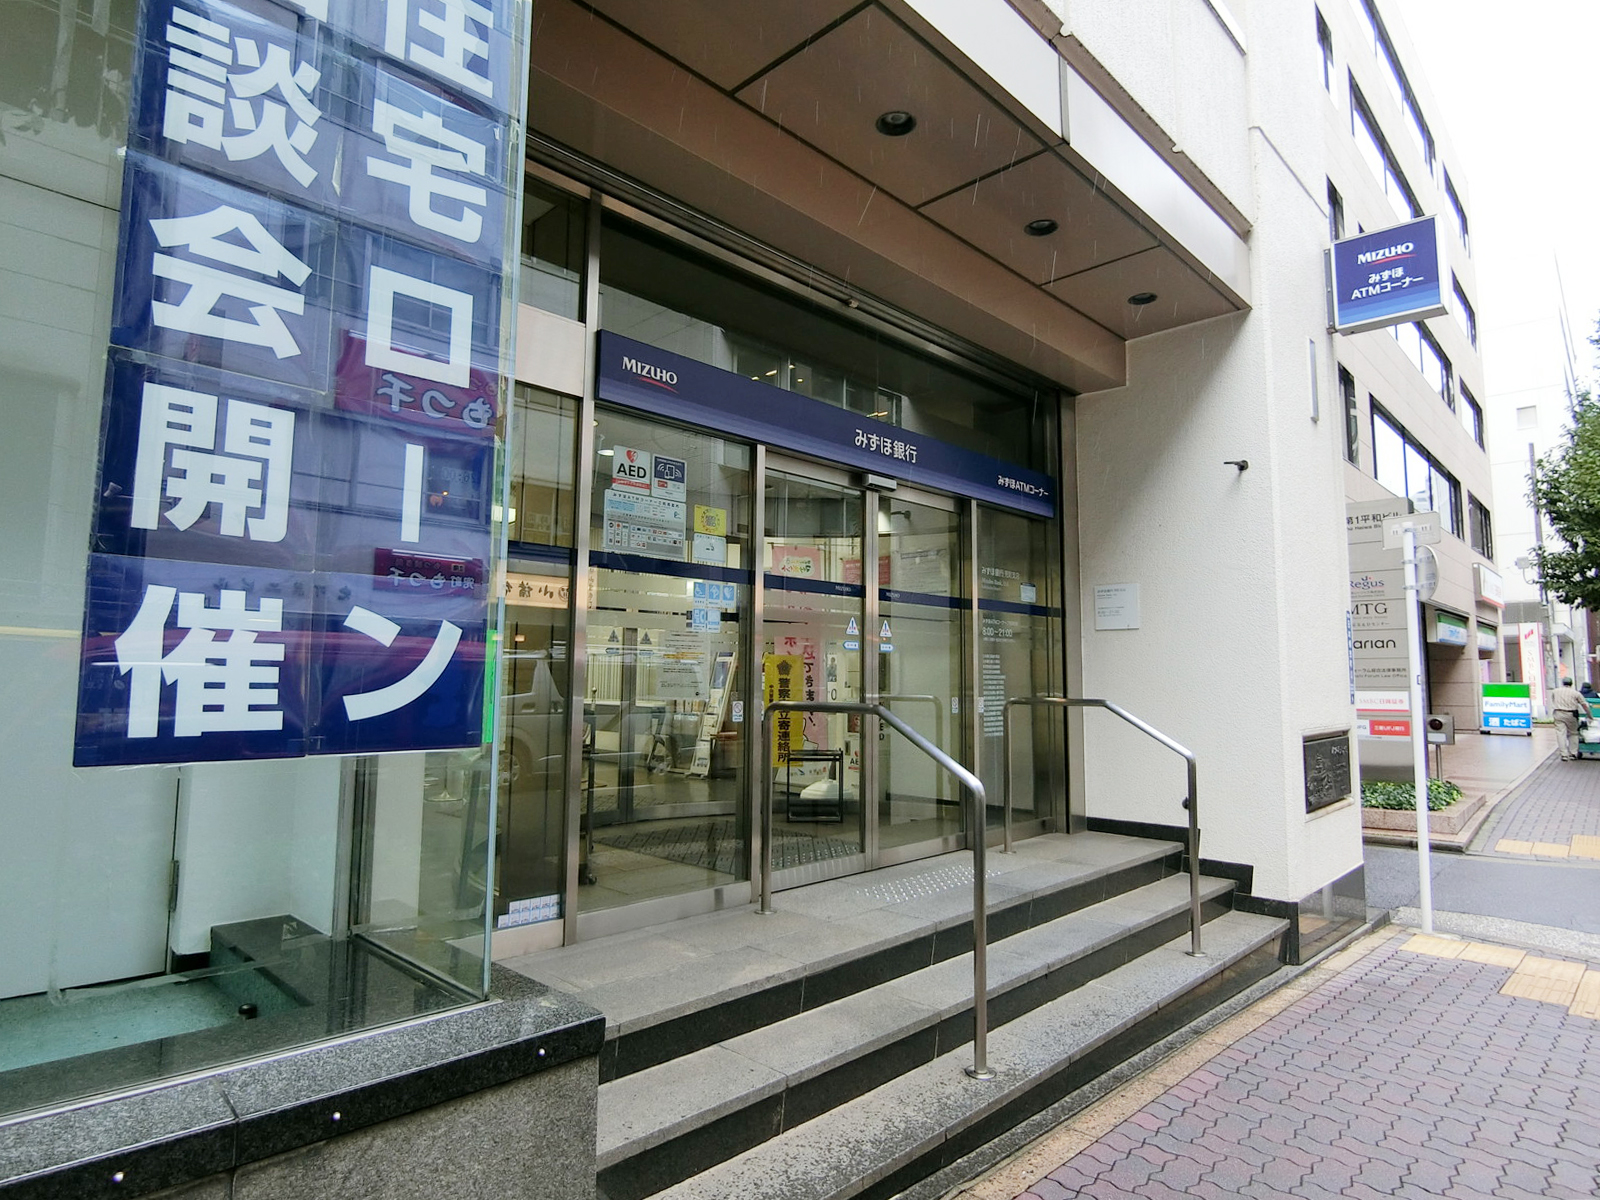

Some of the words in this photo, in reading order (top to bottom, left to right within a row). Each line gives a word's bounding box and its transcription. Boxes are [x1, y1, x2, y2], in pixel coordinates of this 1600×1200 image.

[1357, 242, 1414, 265] MIZUHO
[1368, 266, 1405, 284] みずほ
[1350, 276, 1425, 300] ATMコーナー
[114, 0, 327, 738] 談会開催
[622, 356, 678, 385] MIZUHO
[854, 428, 918, 463] みずほ銀行
[616, 462, 647, 479] AED
[997, 474, 1049, 497] みずほATMコーナー
[1484, 700, 1528, 709] FamilyMart
[777, 677, 791, 763] 警察立寄連絡所
[1503, 718, 1527, 727] たばこ
